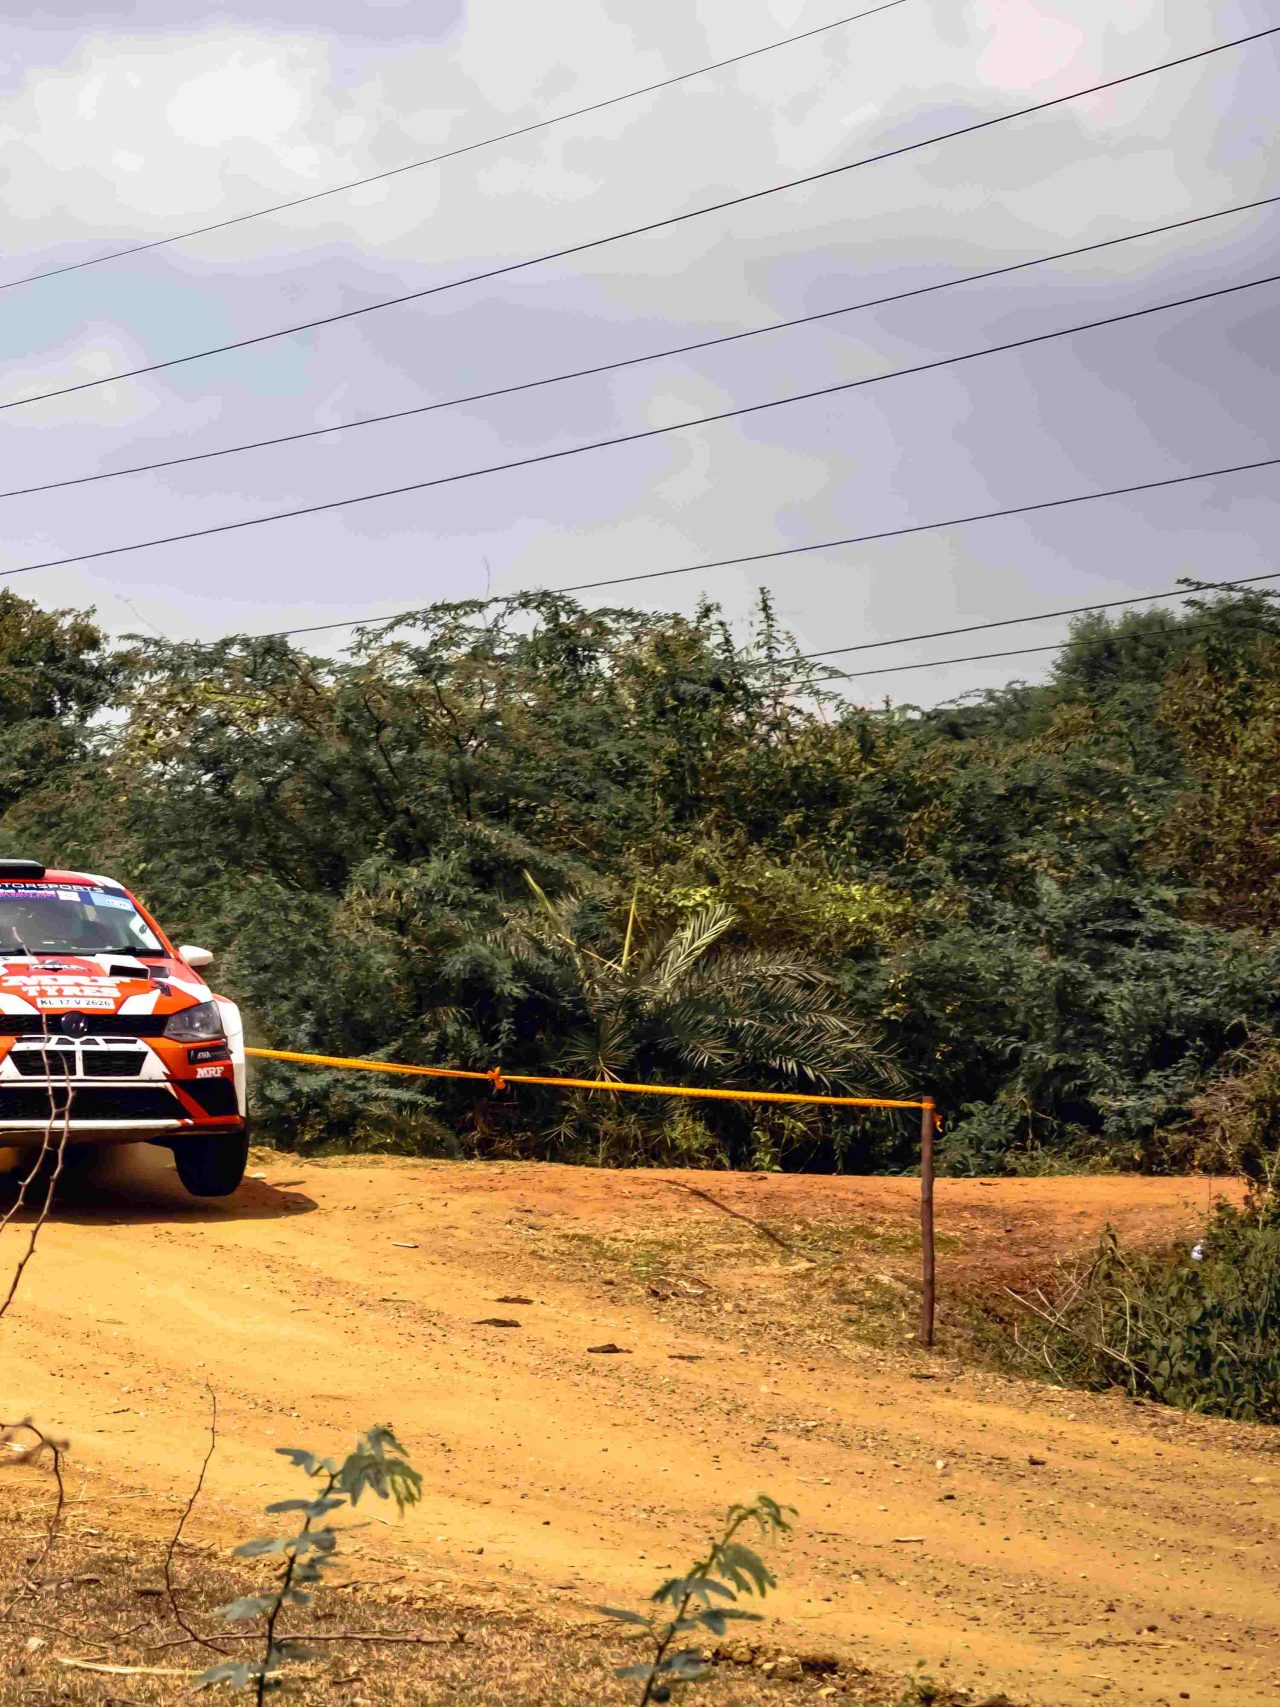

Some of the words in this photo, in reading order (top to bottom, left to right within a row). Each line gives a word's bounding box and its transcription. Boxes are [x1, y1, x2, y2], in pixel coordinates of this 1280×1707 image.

[2, 975, 131, 987] MRF
[21, 986, 122, 997] TYRES
[195, 1066, 225, 1079] MRF
